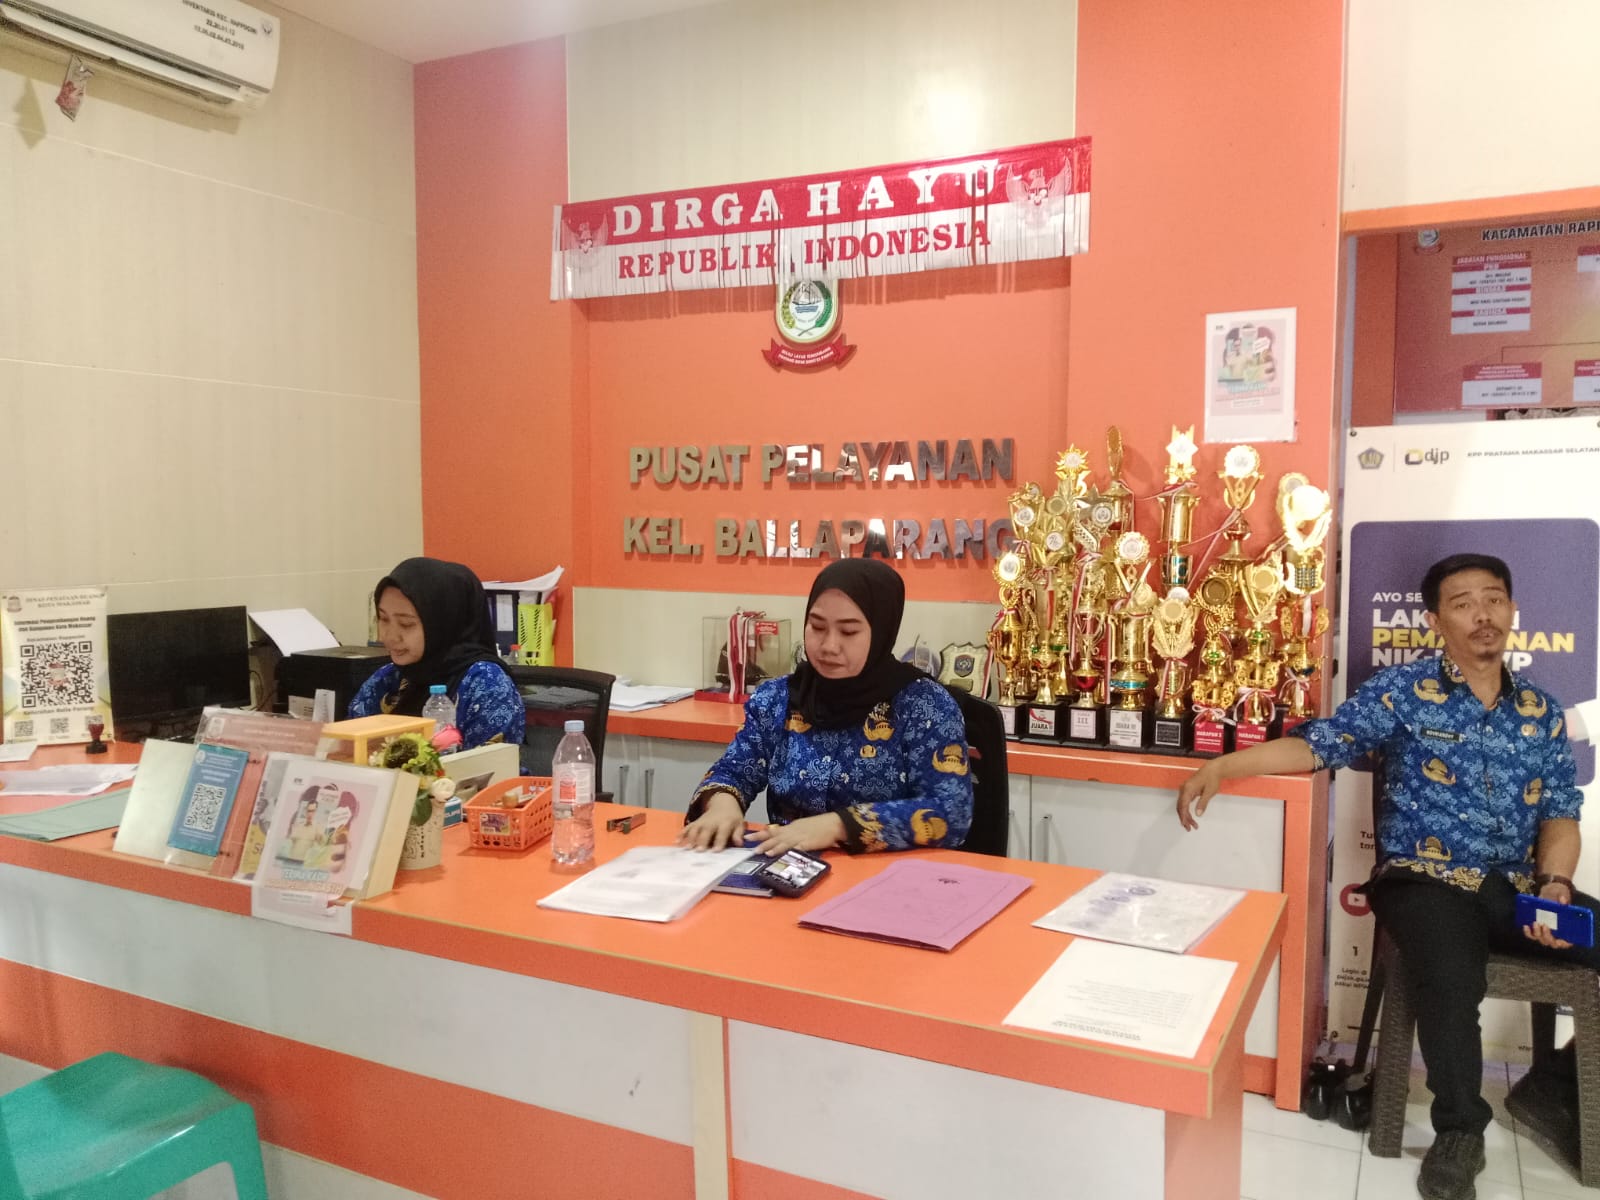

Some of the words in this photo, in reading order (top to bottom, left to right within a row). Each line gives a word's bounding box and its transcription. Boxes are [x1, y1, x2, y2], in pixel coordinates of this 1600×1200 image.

[612, 189, 784, 237] DIRGA
[806, 158, 1000, 218] HAYU
[1482, 223, 1564, 241] KACAMATAN
[618, 243, 777, 279] REPUBLIK
[804, 219, 991, 265] INDONESIA
[629, 445, 749, 484] PUSAT
[761, 438, 1014, 483] PELAYANAN
[1424, 448, 1450, 465] djp
[1521, 448, 1564, 457] MAKASSAR
[623, 516, 703, 556] KEL.
[715, 517, 1017, 561] BALLAPARANG
[1372, 591, 1402, 603] AYO
[1372, 627, 1575, 653] PEMNAN
[1031, 722, 1049, 730] JUARA
[1352, 945, 1359, 957] 1
